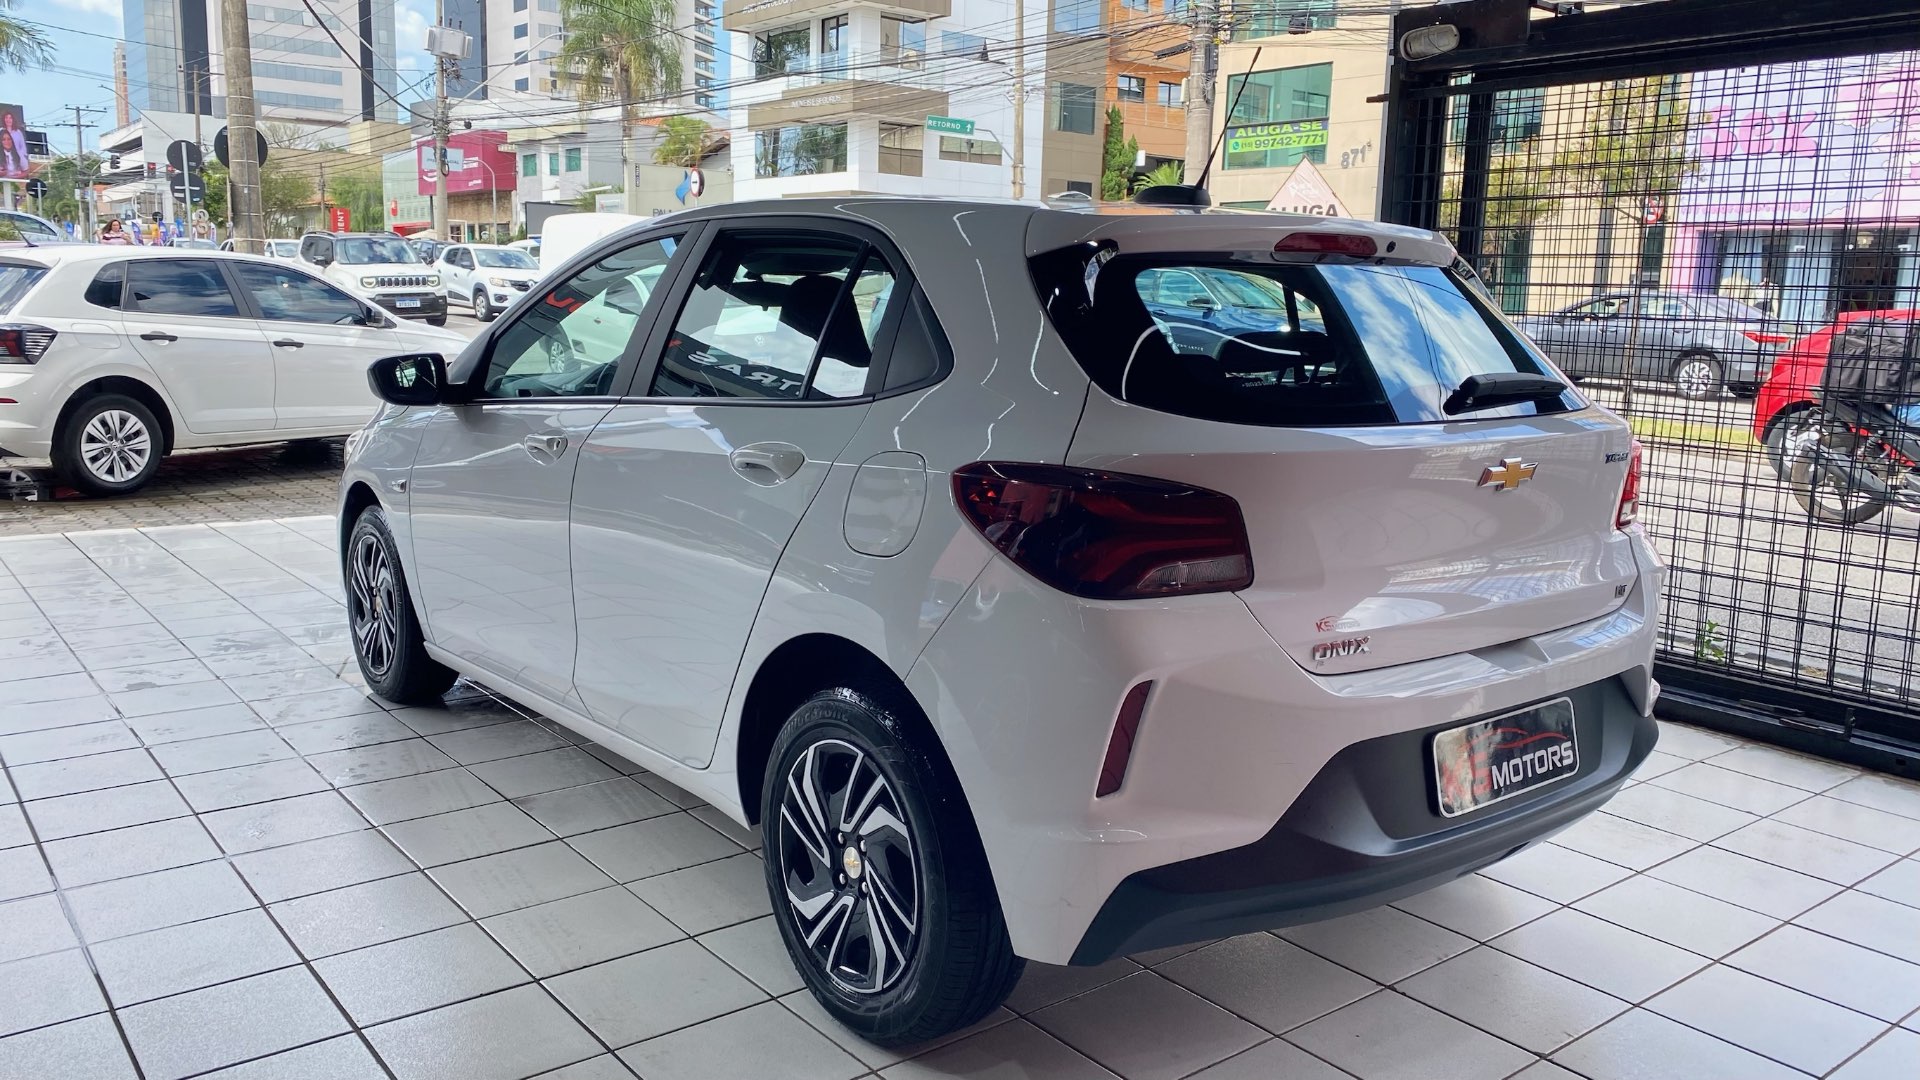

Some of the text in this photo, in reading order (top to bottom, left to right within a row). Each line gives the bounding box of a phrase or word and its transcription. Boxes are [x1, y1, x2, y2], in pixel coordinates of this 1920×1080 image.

[927, 119, 961, 130] RETORNO
[1235, 121, 1323, 138] ALUGA-SE
[1254, 132, 1325, 149] 99742-7771
[1340, 144, 1367, 169] 871
[337, 209, 345, 233] IENT
[1315, 620, 1333, 633] KS
[1312, 635, 1372, 661] ONIX
[1491, 740, 1575, 790] MOTORS
